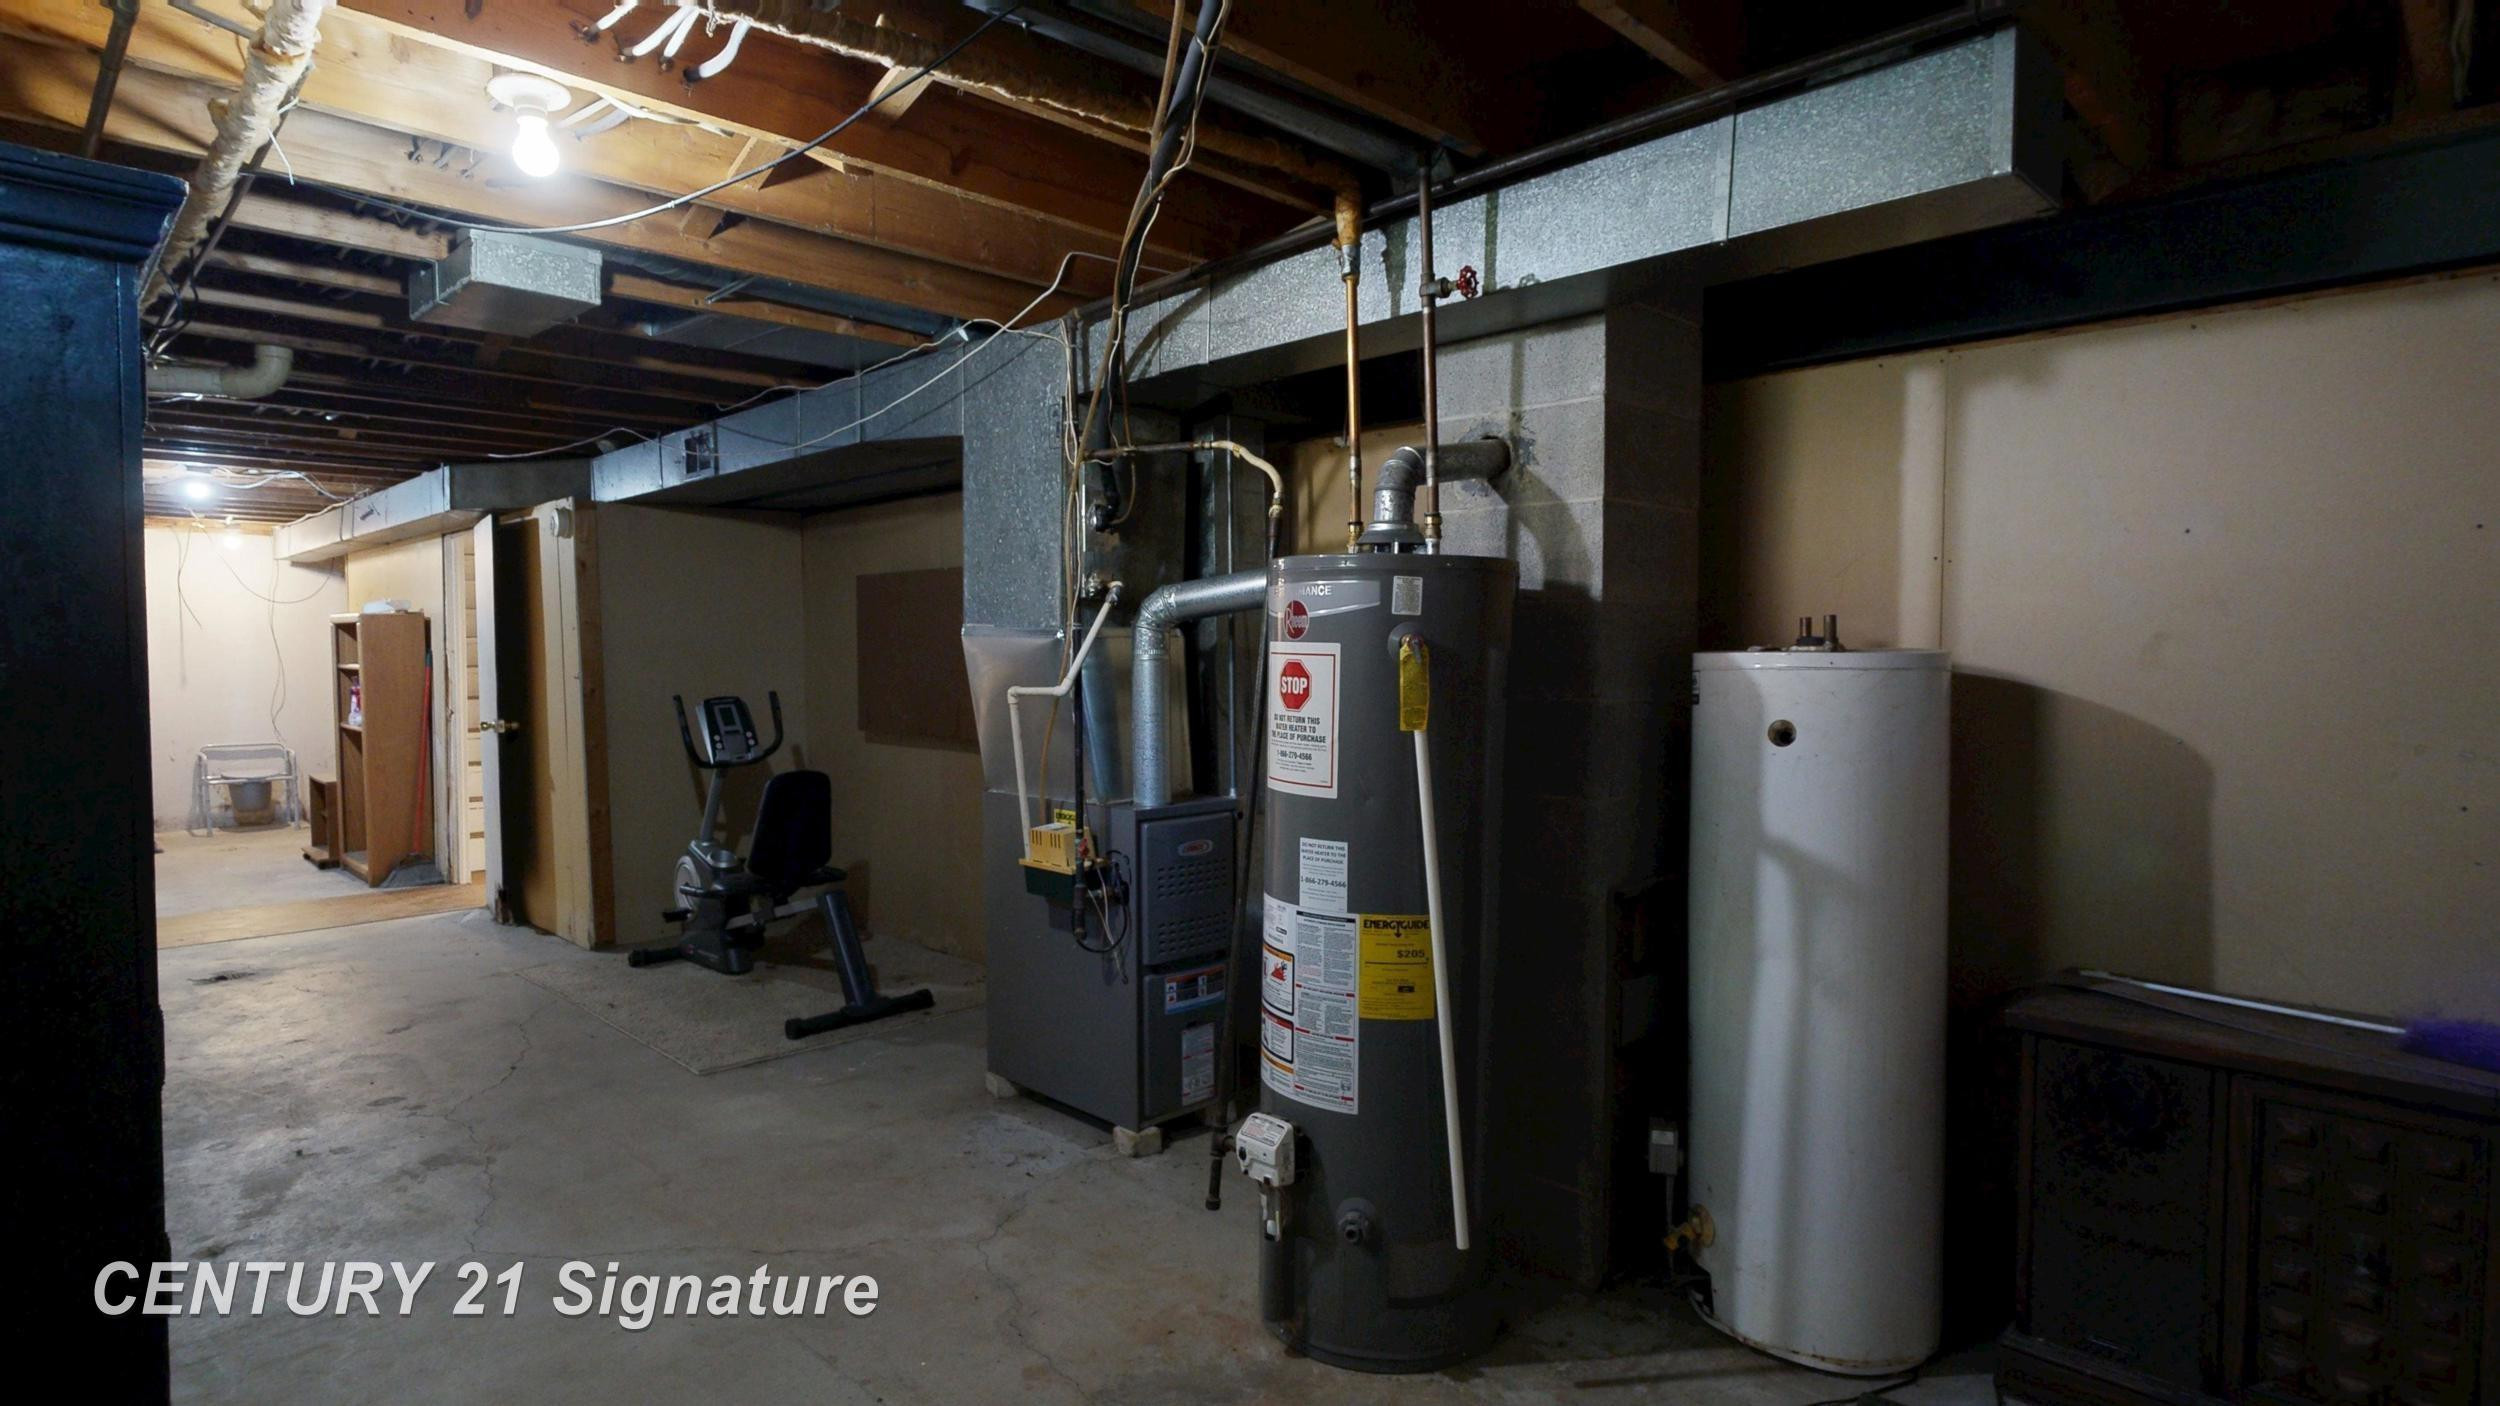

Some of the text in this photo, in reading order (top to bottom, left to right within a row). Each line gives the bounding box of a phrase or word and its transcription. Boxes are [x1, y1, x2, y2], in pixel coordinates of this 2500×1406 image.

[1281, 676, 1308, 695] STOP
[1287, 715, 1306, 724] RETURN
[1307, 716, 1321, 725] THIS
[1276, 722, 1317, 734] WATER HEATER TO
[1277, 731, 1289, 739] PLACE
[1289, 732, 1295, 740] OF
[1296, 734, 1326, 743] PURCHASE
[1364, 919, 1429, 929] ENERGYGUIDE
[1397, 950, 1424, 959] $205
